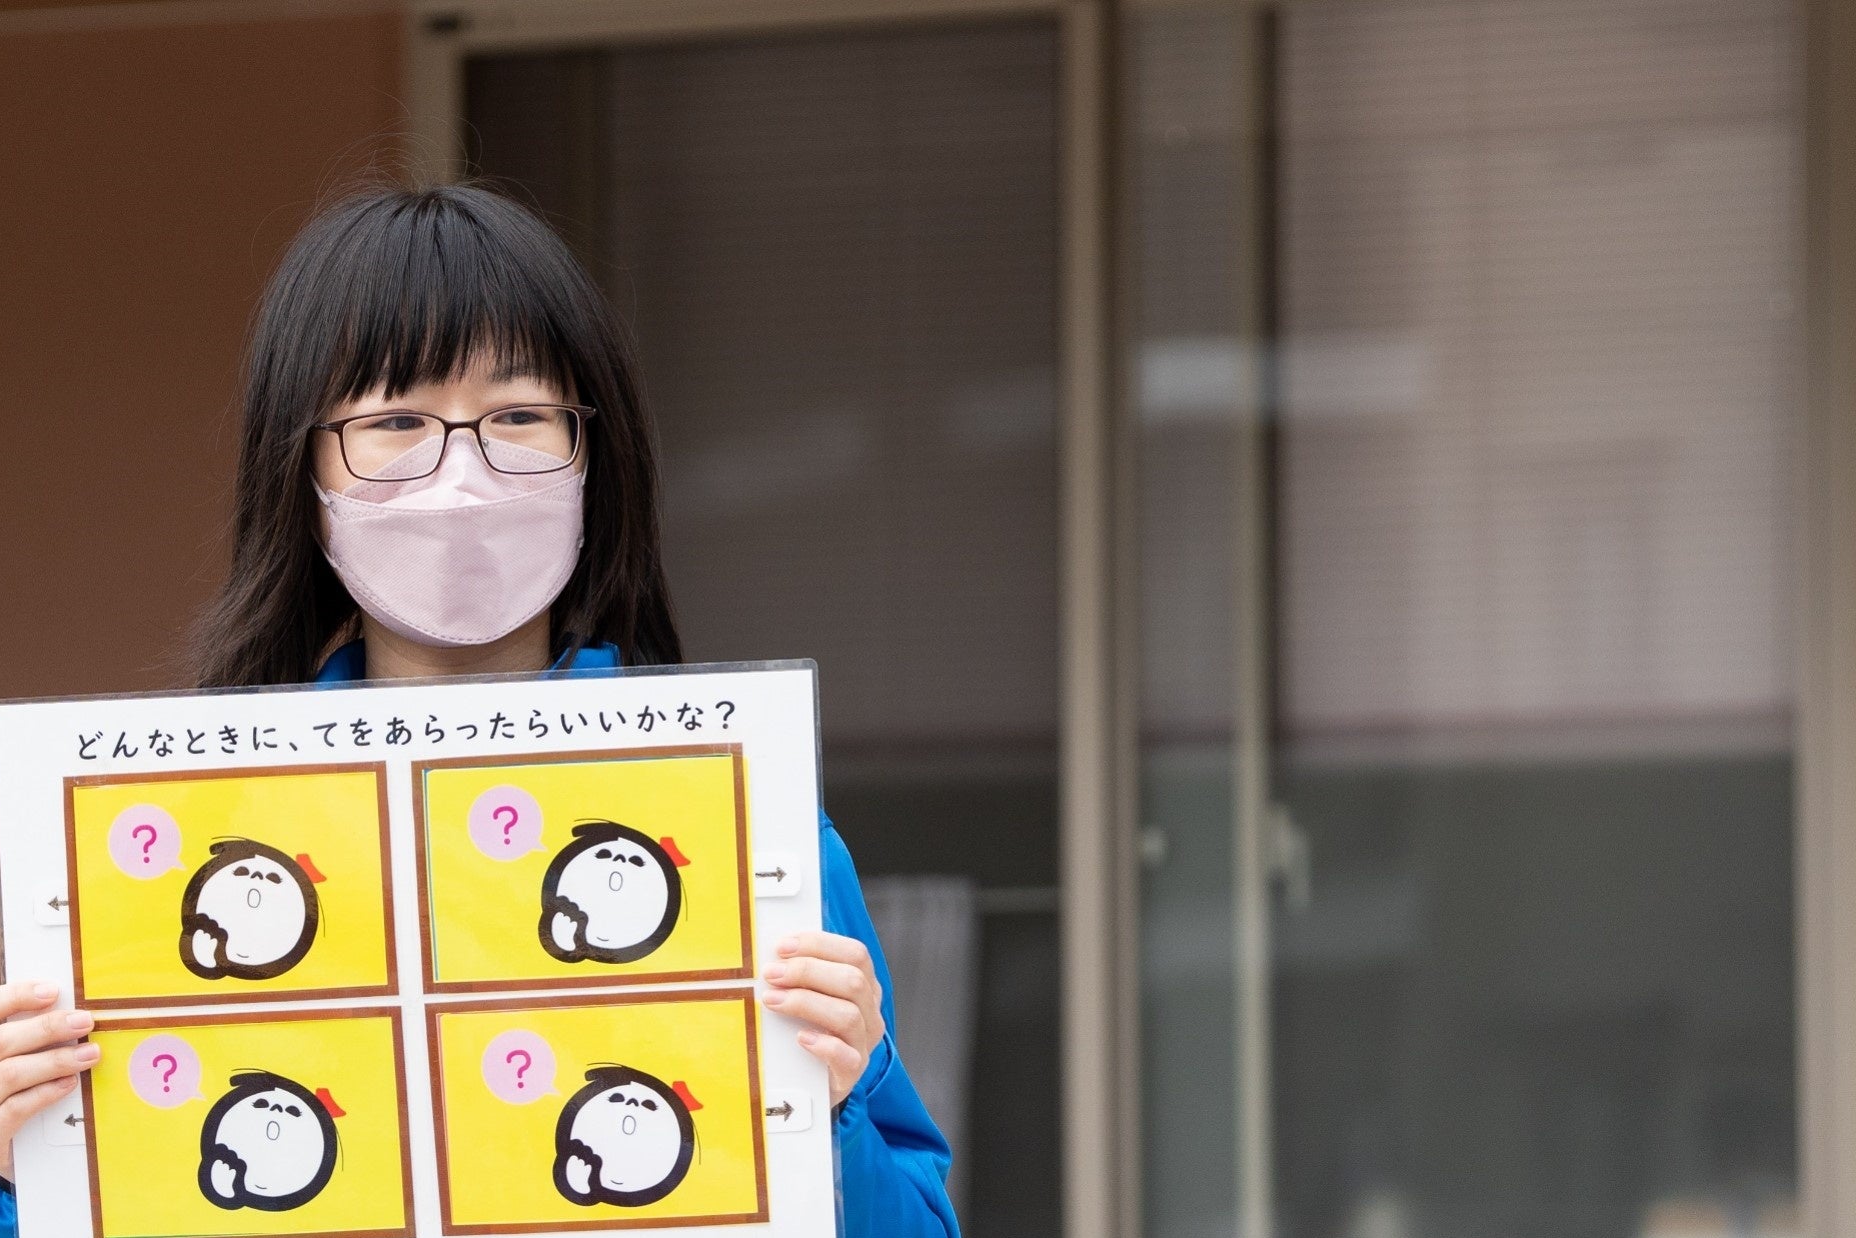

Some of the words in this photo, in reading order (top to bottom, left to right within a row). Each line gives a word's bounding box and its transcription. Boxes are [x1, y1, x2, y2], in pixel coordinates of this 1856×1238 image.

[130, 823, 158, 865] ?
[490, 804, 520, 846] ?
[150, 1053, 178, 1093] ?
[504, 1048, 533, 1090] ?
